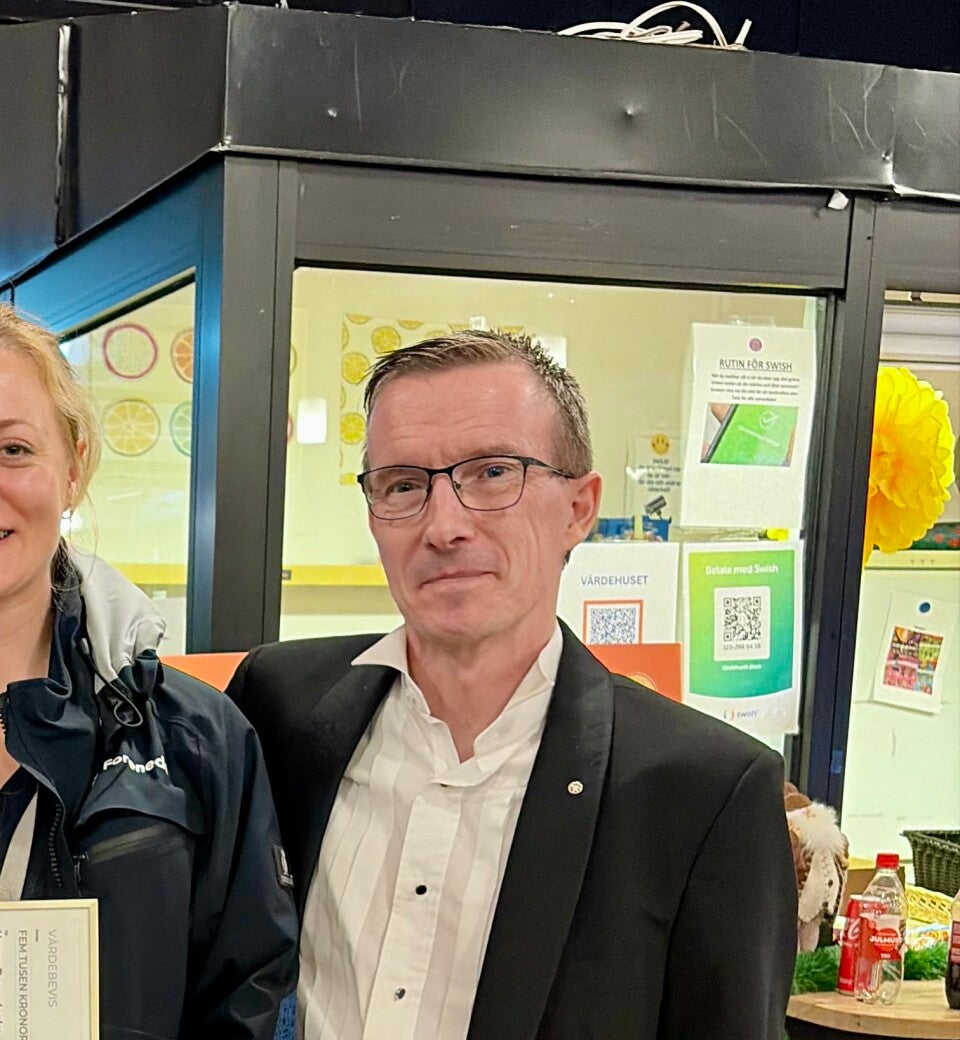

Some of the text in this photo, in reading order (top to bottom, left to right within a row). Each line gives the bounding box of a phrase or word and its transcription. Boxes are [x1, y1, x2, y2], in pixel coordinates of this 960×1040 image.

[720, 358, 792, 371] RUTIN FÖR SWISH
[705, 563, 778, 575] Betala med Swish
[18, 930, 27, 952] FEM
[18, 955, 28, 991] TUSEN
